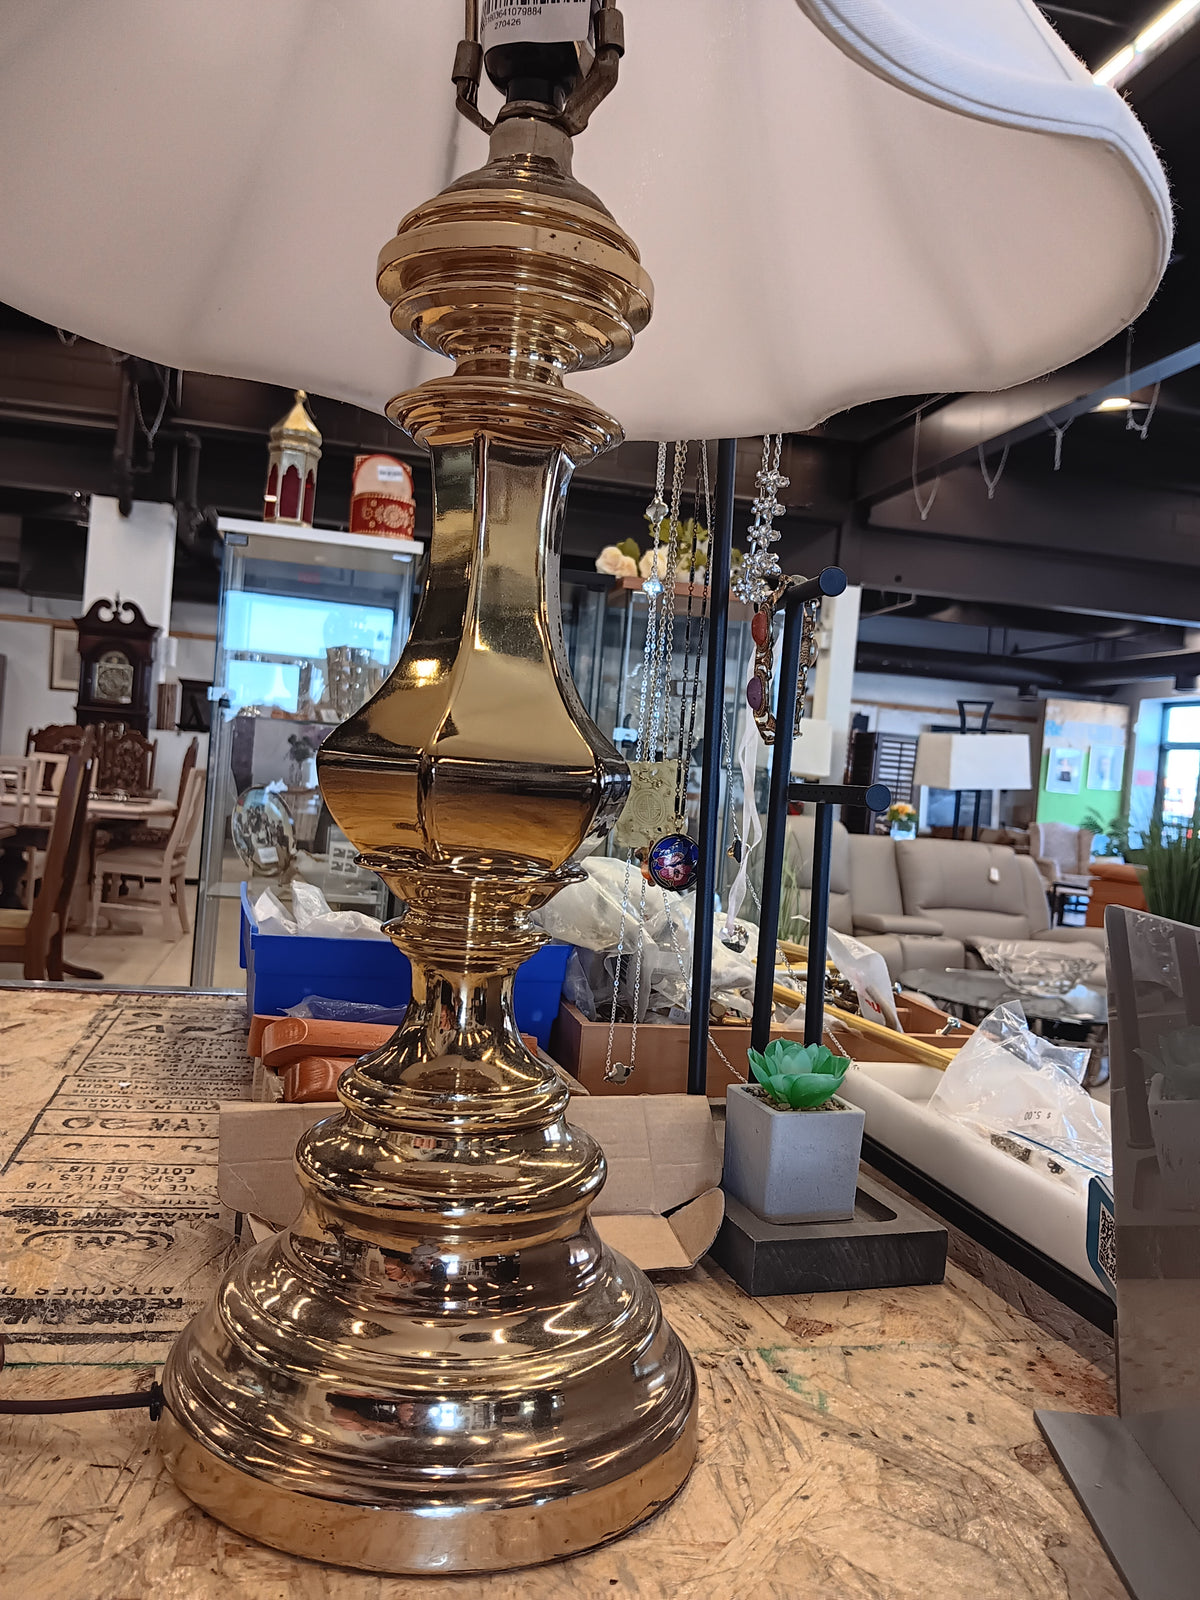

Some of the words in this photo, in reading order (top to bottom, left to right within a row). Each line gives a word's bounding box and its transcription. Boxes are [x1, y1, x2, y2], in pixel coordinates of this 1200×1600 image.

[494, 18, 521, 30] 270426
[1024, 1110, 1042, 1121] 5.00
[59, 1174, 95, 1182] LES
[134, 1220, 177, 1228] APA
